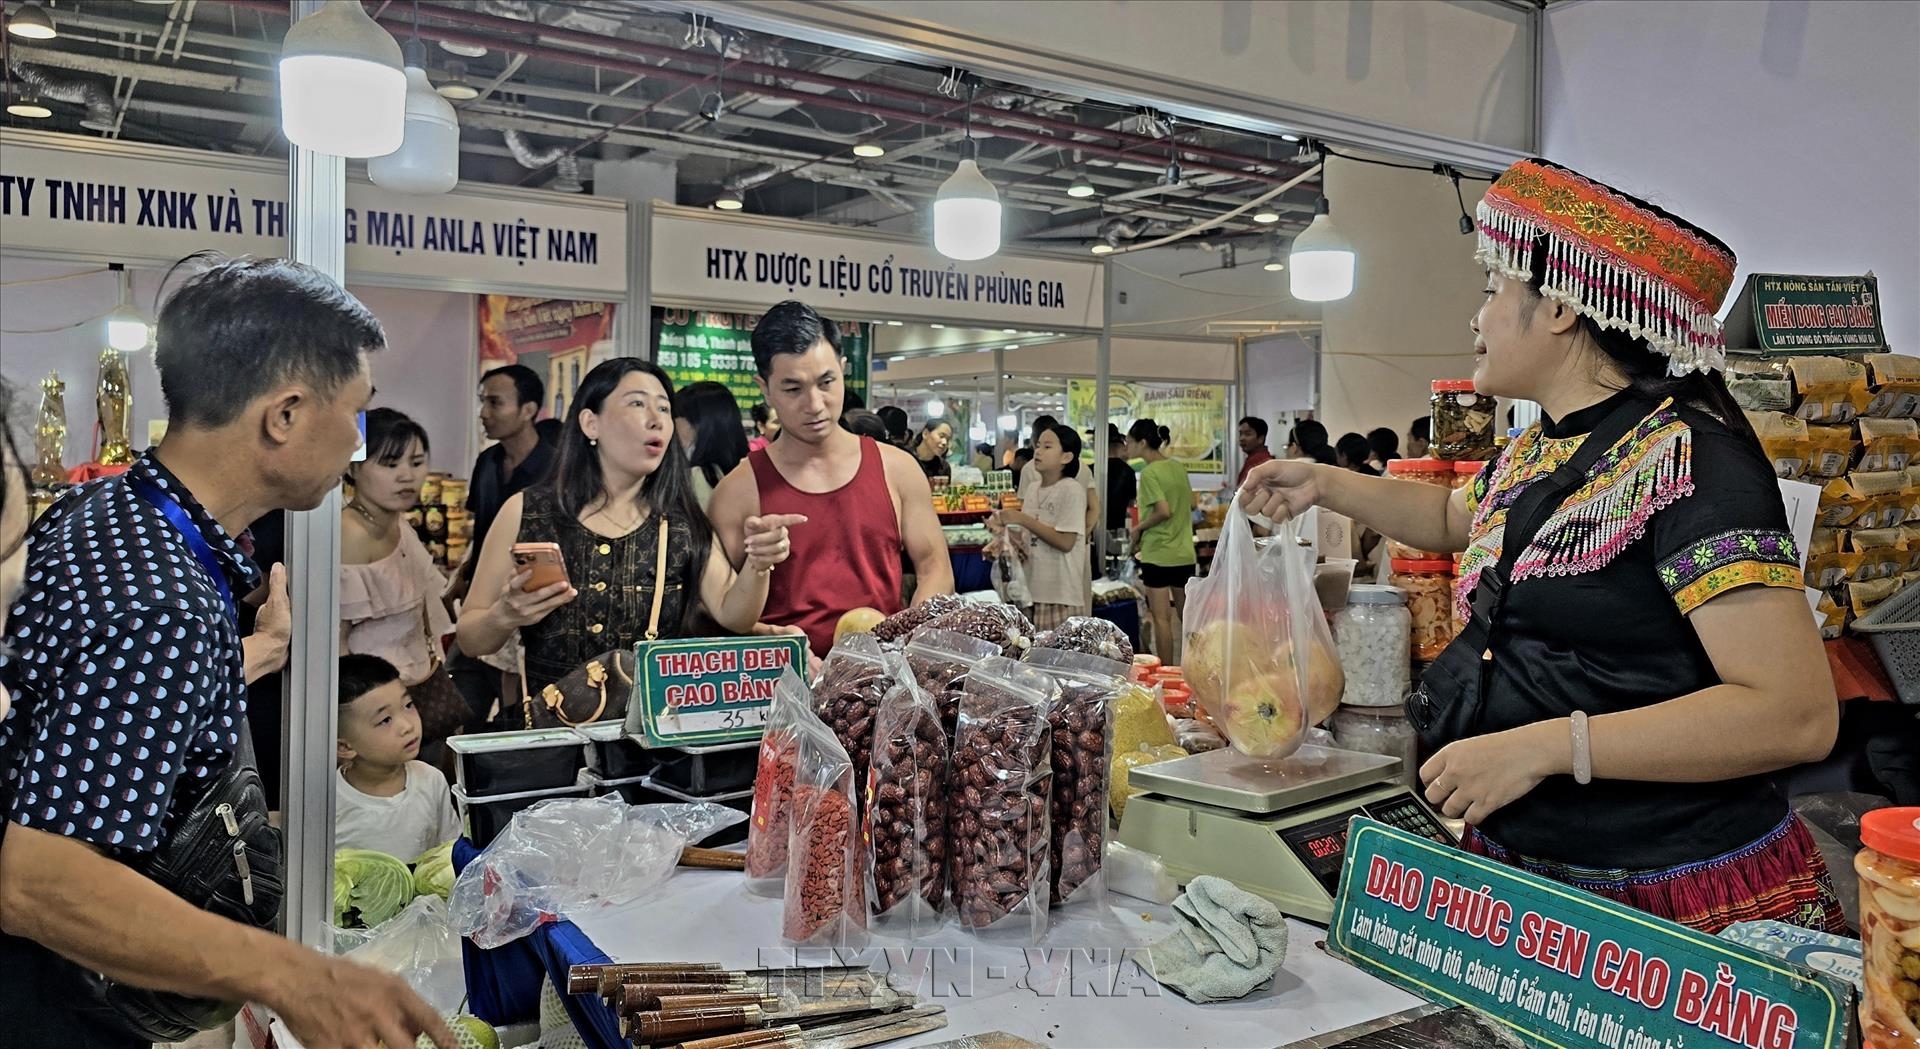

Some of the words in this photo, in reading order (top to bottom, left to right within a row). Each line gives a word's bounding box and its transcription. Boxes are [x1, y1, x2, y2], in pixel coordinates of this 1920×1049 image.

[0, 175, 35, 217] TY
[45, 179, 126, 224] TNHH
[136, 188, 197, 230] XNK
[207, 188, 243, 234] VÀ
[367, 210, 414, 256] MẠI
[423, 216, 486, 255] ANLA
[493, 218, 540, 266] VIỆT
[548, 228, 598, 265] NAM
[707, 247, 748, 282] HTX
[756, 252, 811, 292] DƯỢC
[819, 254, 860, 297] LIỆU
[868, 253, 894, 294] CỔ
[975, 271, 1032, 306] PHÙNG
[1038, 280, 1065, 309] GIA
[1764, 281, 1781, 291] HTX
[1783, 280, 1806, 292] NÔNG
[1764, 296, 1796, 329] MIẾN
[1795, 303, 1826, 329] DONG
[1826, 303, 1848, 329] CAO
[1847, 296, 1875, 329] BẰNG
[1772, 333, 1786, 345] LÀM
[656, 650, 737, 678] THẠCH
[742, 646, 792, 669] ĐEN
[665, 684, 717, 708] CAO
[718, 709, 749, 731] 35
[1366, 854, 1424, 912] DAO
[1425, 876, 1513, 947] PHÚC
[1516, 911, 1590, 979] SEN
[1592, 939, 1671, 1010] CAO
[1674, 962, 1798, 1049] BẰNG
[1351, 907, 1373, 943] Làm
[1373, 912, 1398, 955] bằng
[1397, 925, 1417, 961] sắt
[1416, 937, 1444, 974] nhíp
[1442, 945, 1464, 985] ôtô,
[1465, 957, 1501, 996] chuôi
[1498, 968, 1518, 1005] gỗ
[1517, 975, 1548, 1017] Cẩm
[1550, 990, 1573, 1033] Chỉ,
[1573, 1002, 1598, 1039] rèn
[1598, 1011, 1624, 1049] thủ
